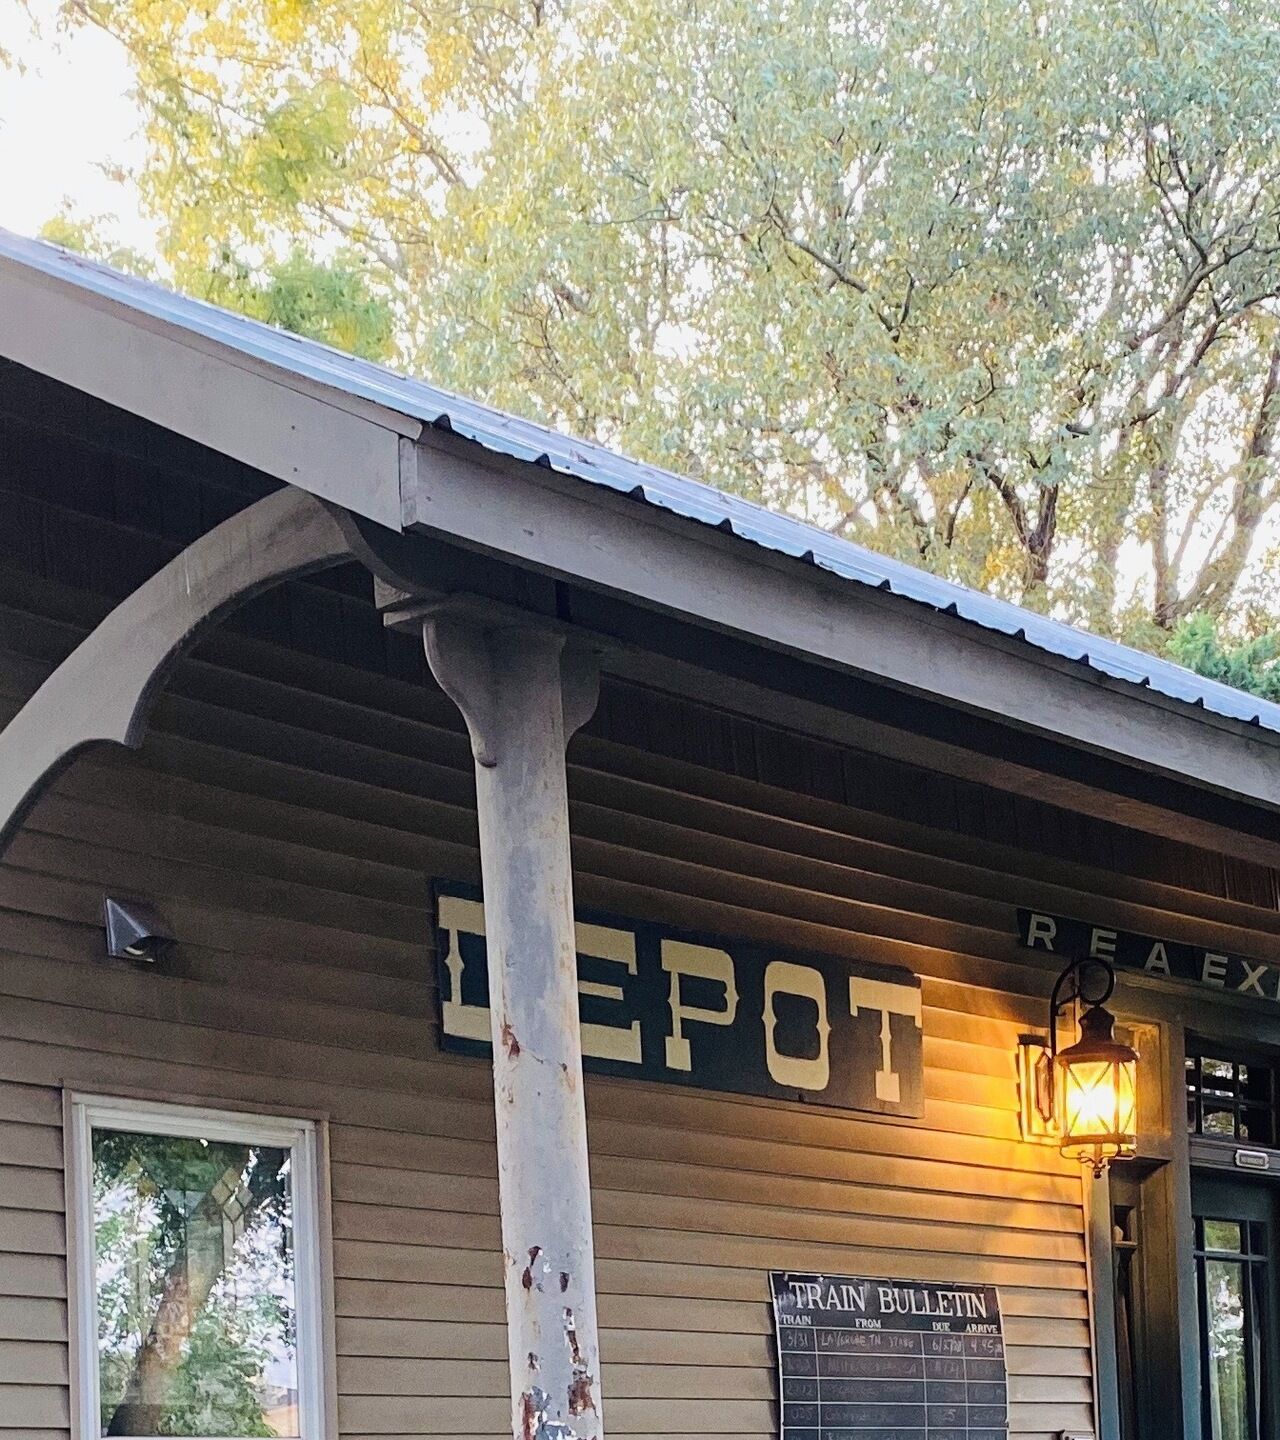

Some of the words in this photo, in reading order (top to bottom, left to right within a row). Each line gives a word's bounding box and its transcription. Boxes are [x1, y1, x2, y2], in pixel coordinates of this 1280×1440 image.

[789, 1281, 866, 1312] TRAIN
[877, 1287, 988, 1318] BULLETIN
[782, 1314, 812, 1325] TRAIN
[855, 1318, 882, 1329] FROM
[932, 1321, 951, 1332] DUE
[966, 1324, 999, 1334] ARRIVE
